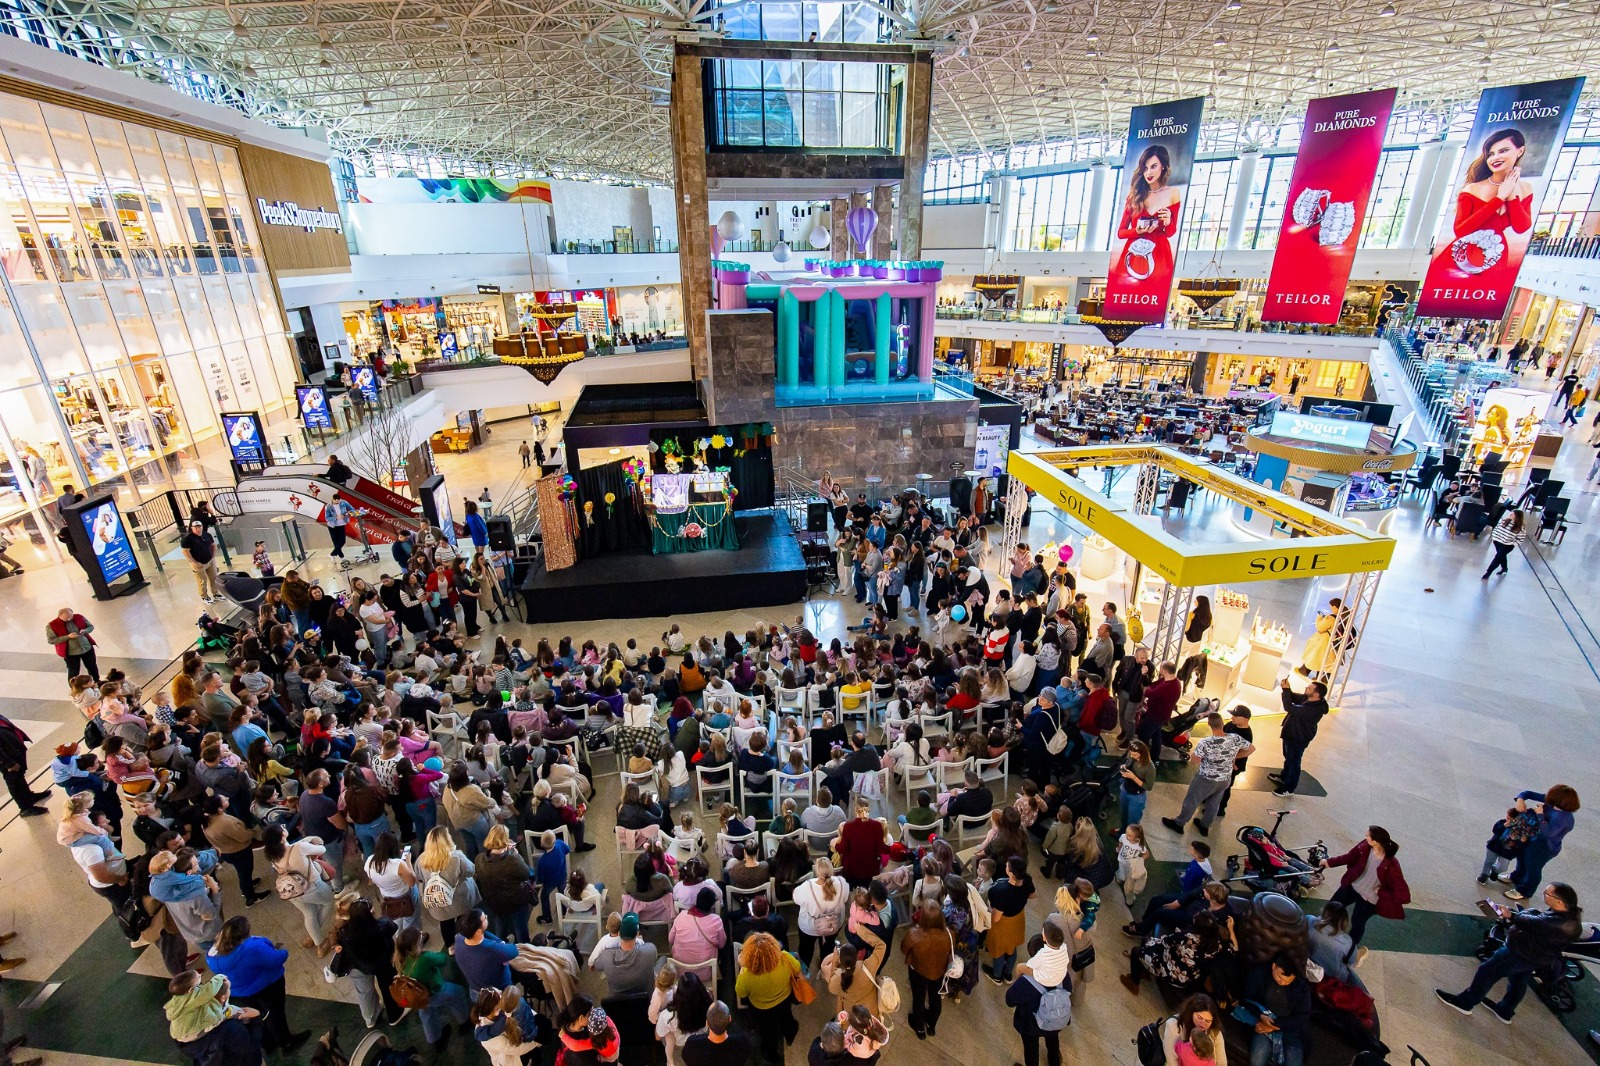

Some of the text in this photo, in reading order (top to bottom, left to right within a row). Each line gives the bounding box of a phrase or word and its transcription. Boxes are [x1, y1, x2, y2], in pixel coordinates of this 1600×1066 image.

[1516, 99, 1541, 110] PURE
[1334, 109, 1360, 120] PURE
[1487, 106, 1560, 123] DIAMONDS
[1153, 116, 1174, 127] PURE
[1314, 116, 1377, 133] DIAMONDS
[1137, 123, 1188, 139] DIAMONDS
[1113, 293, 1158, 305] TEILOR
[1276, 293, 1331, 305] TEILOR
[1433, 288, 1496, 301] TEILOR
[1058, 489, 1097, 525] SOLE
[1248, 553, 1329, 575] SOLE
